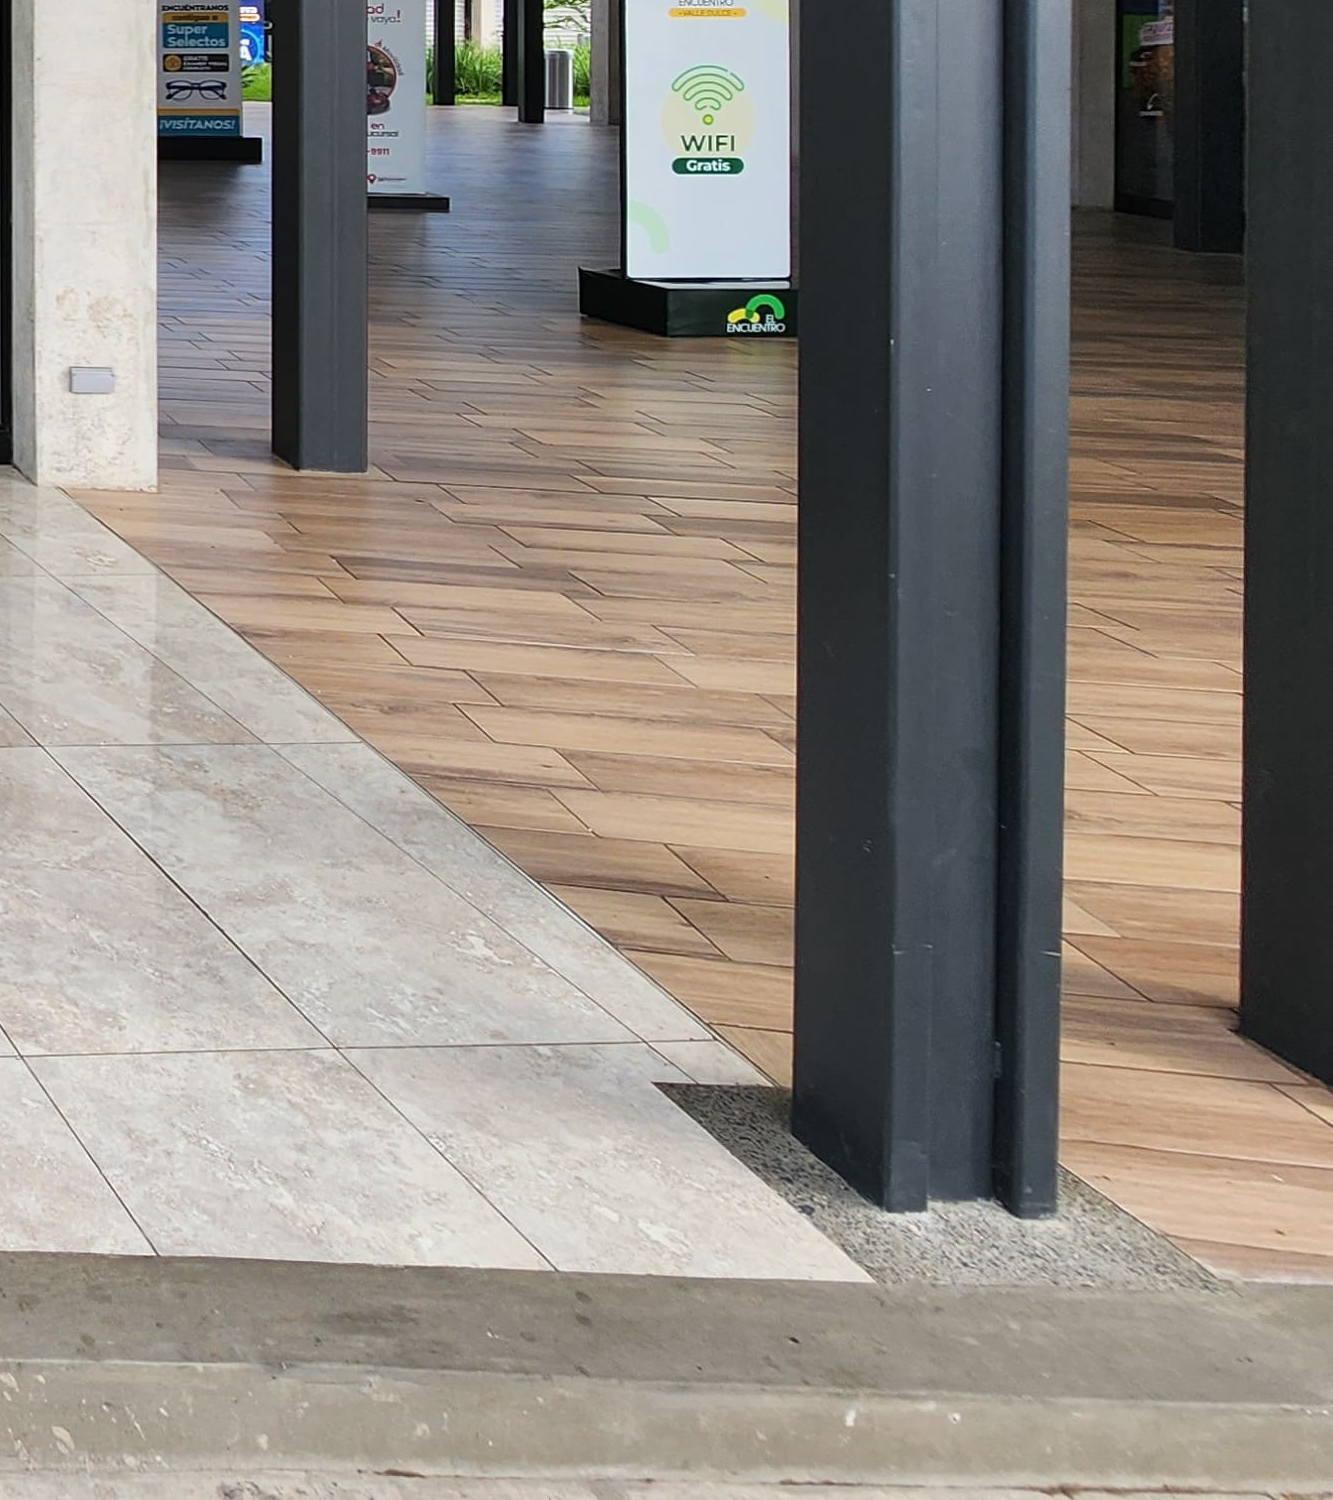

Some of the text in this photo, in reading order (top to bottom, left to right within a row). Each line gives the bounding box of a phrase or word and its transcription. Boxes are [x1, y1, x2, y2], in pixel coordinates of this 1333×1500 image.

[167, 24, 208, 37] Super
[167, 36, 226, 47] Selectos
[159, 117, 236, 130] ¡VISÍTANOS!
[367, 130, 399, 138] ucursal
[681, 135, 735, 151] WIFI
[686, 159, 731, 172] Gratis
[765, 314, 776, 323] EL
[727, 322, 786, 333] ENCUENTRO
